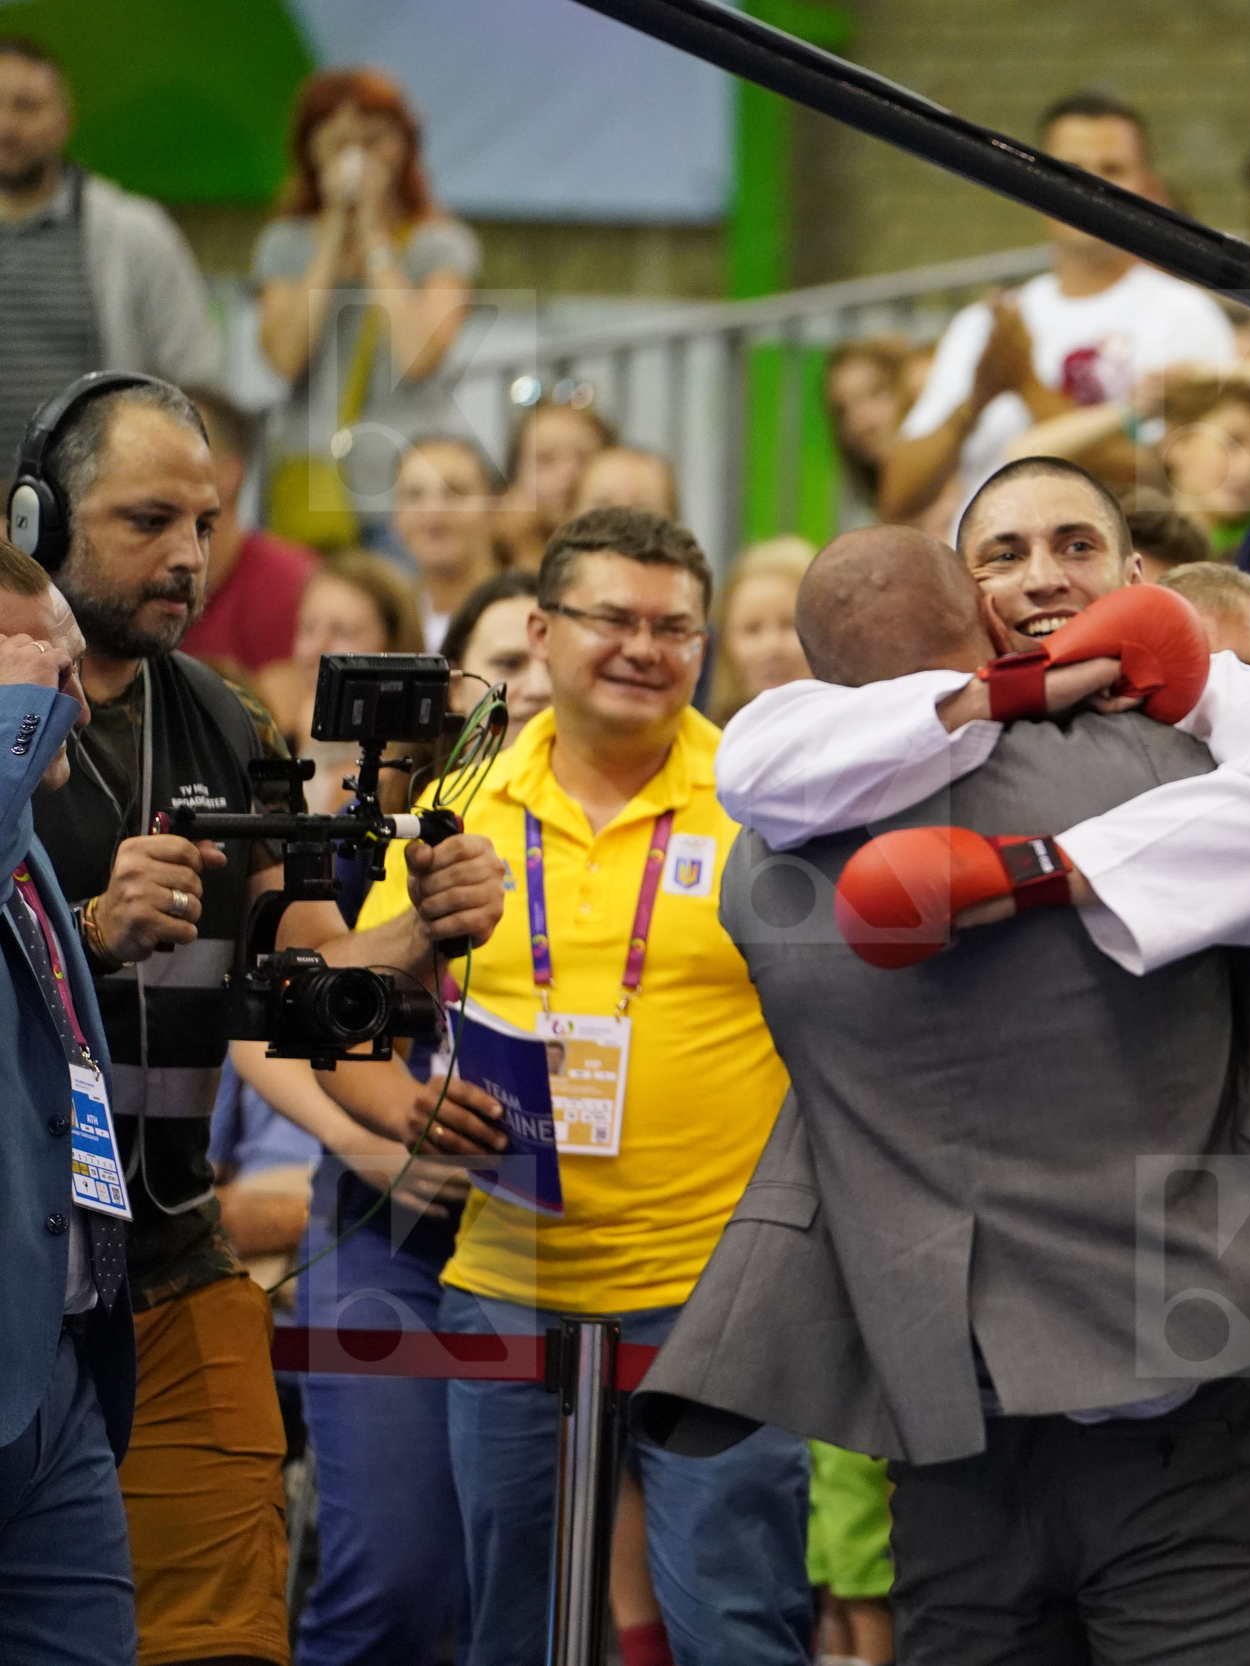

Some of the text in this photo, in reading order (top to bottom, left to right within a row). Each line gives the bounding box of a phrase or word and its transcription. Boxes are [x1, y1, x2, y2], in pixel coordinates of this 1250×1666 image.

[179, 785, 193, 797] TV
[483, 1078, 523, 1112] TEAM
[86, 1113, 99, 1126] ATH
[503, 1108, 554, 1142] AINE
